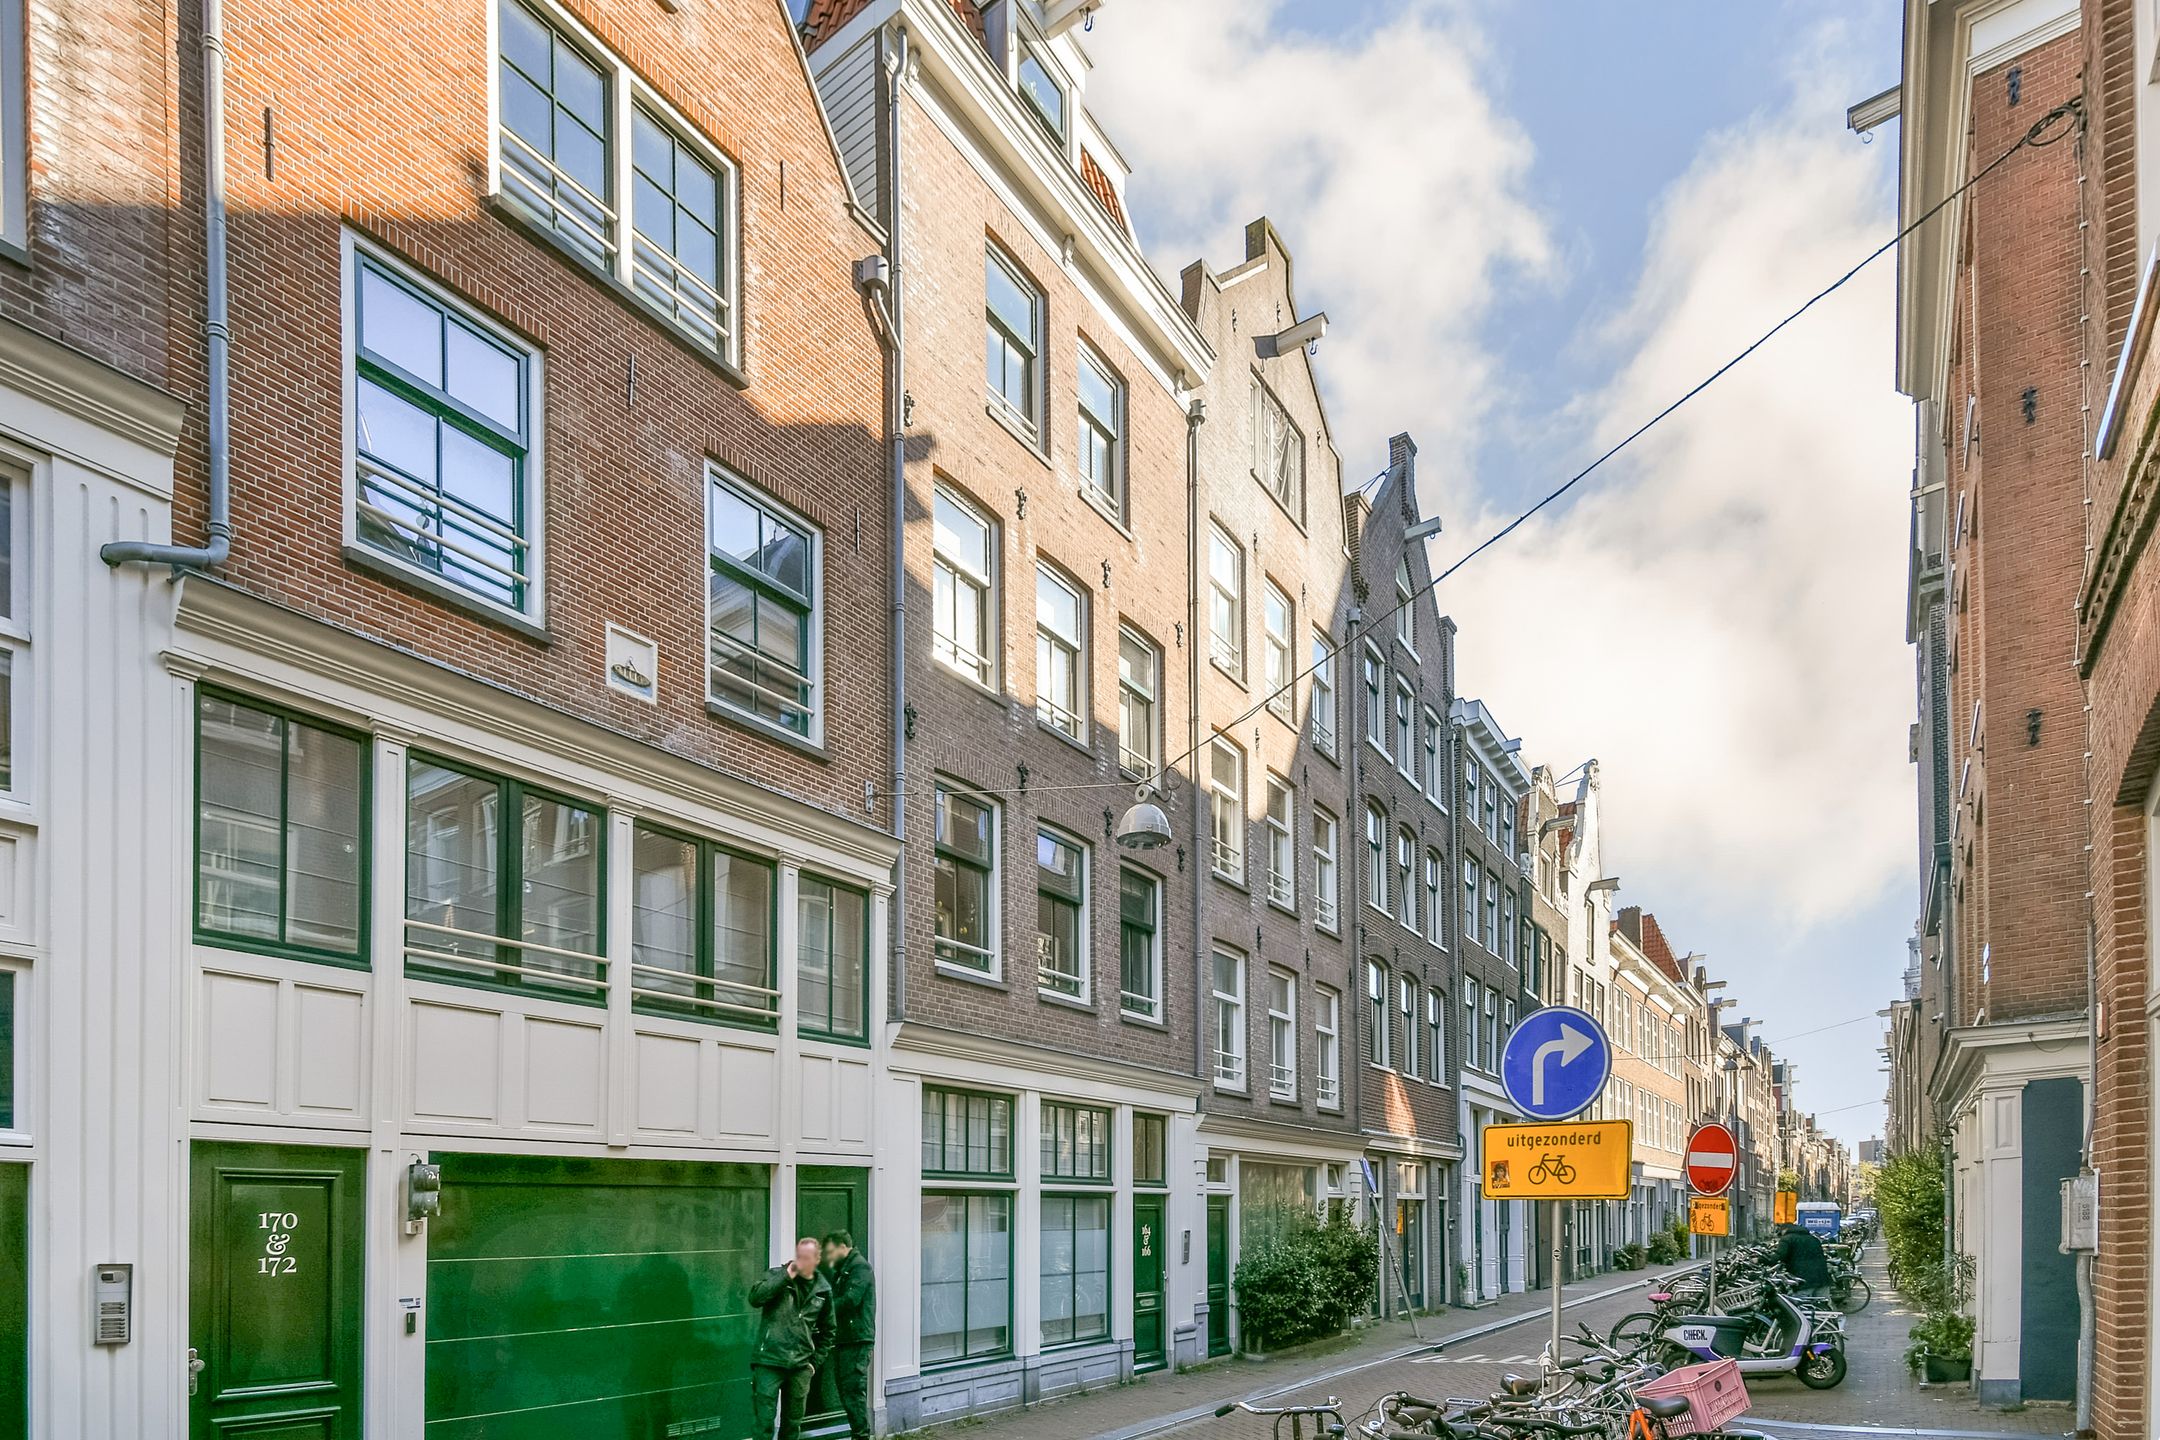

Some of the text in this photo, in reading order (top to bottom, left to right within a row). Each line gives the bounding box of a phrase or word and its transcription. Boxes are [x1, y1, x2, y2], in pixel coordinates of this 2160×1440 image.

[1507, 1131, 1601, 1150] uitgezonderd
[258, 1212, 298, 1233] 170
[266, 1233, 290, 1255] &
[258, 1256, 297, 1277] 172
[1683, 1329, 1708, 1341] CHECK.
